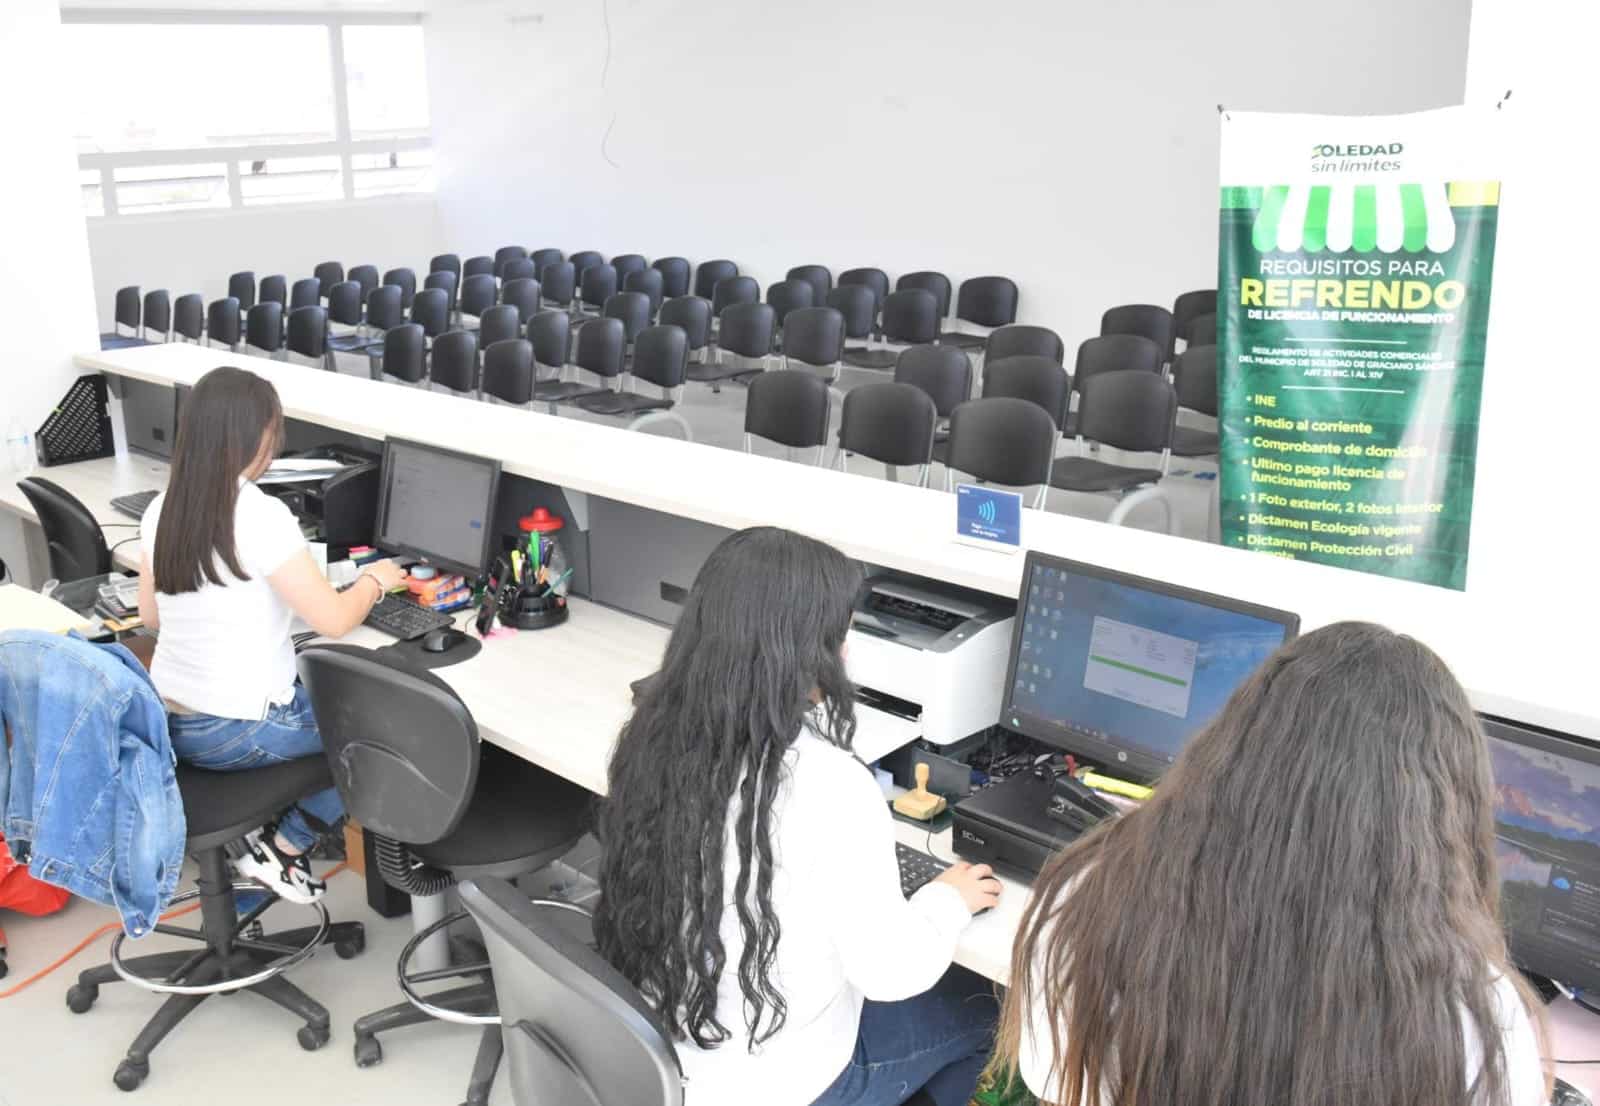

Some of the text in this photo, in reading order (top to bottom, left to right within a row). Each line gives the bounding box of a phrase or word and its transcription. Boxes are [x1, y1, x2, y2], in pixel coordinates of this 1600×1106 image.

[1311, 160, 1337, 173] sin
[1260, 259, 1445, 276] REQUISITOS PARA
[1240, 278, 1465, 310] REFRENDO
[1247, 309, 1455, 324] DE LICENCIA DE FUNCIONAMIENTO
[1239, 355, 1253, 363] DEL
[1298, 358, 1309, 367] DE
[1311, 358, 1352, 368] SOLEDAD
[1353, 360, 1366, 369] DE
[1367, 361, 1414, 371] GRACIANO
[1323, 349, 1379, 359] ACTIVIDADES
[1380, 351, 1442, 361] COMERCIALES
[1355, 370, 1367, 378] AL
[1368, 371, 1384, 379] XIV
[1255, 394, 1276, 408] INE
[1254, 416, 1373, 434] Predio al corriente
[1253, 436, 1341, 455] Comprobante
[1344, 443, 1362, 456] de
[1251, 457, 1293, 472] Ultimo
[1295, 464, 1330, 477] pago
[1332, 464, 1385, 479] licencia
[1251, 469, 1351, 491] funcionamiento
[1249, 492, 1256, 503] 1
[1258, 493, 1288, 507] Foto
[1289, 499, 1342, 514] exterior,
[1345, 502, 1355, 513] 2
[1357, 502, 1393, 514] fotos
[1248, 513, 1423, 539] Dictamen Ecología vigente
[1247, 534, 1413, 557] Dictamen Protección Civil
